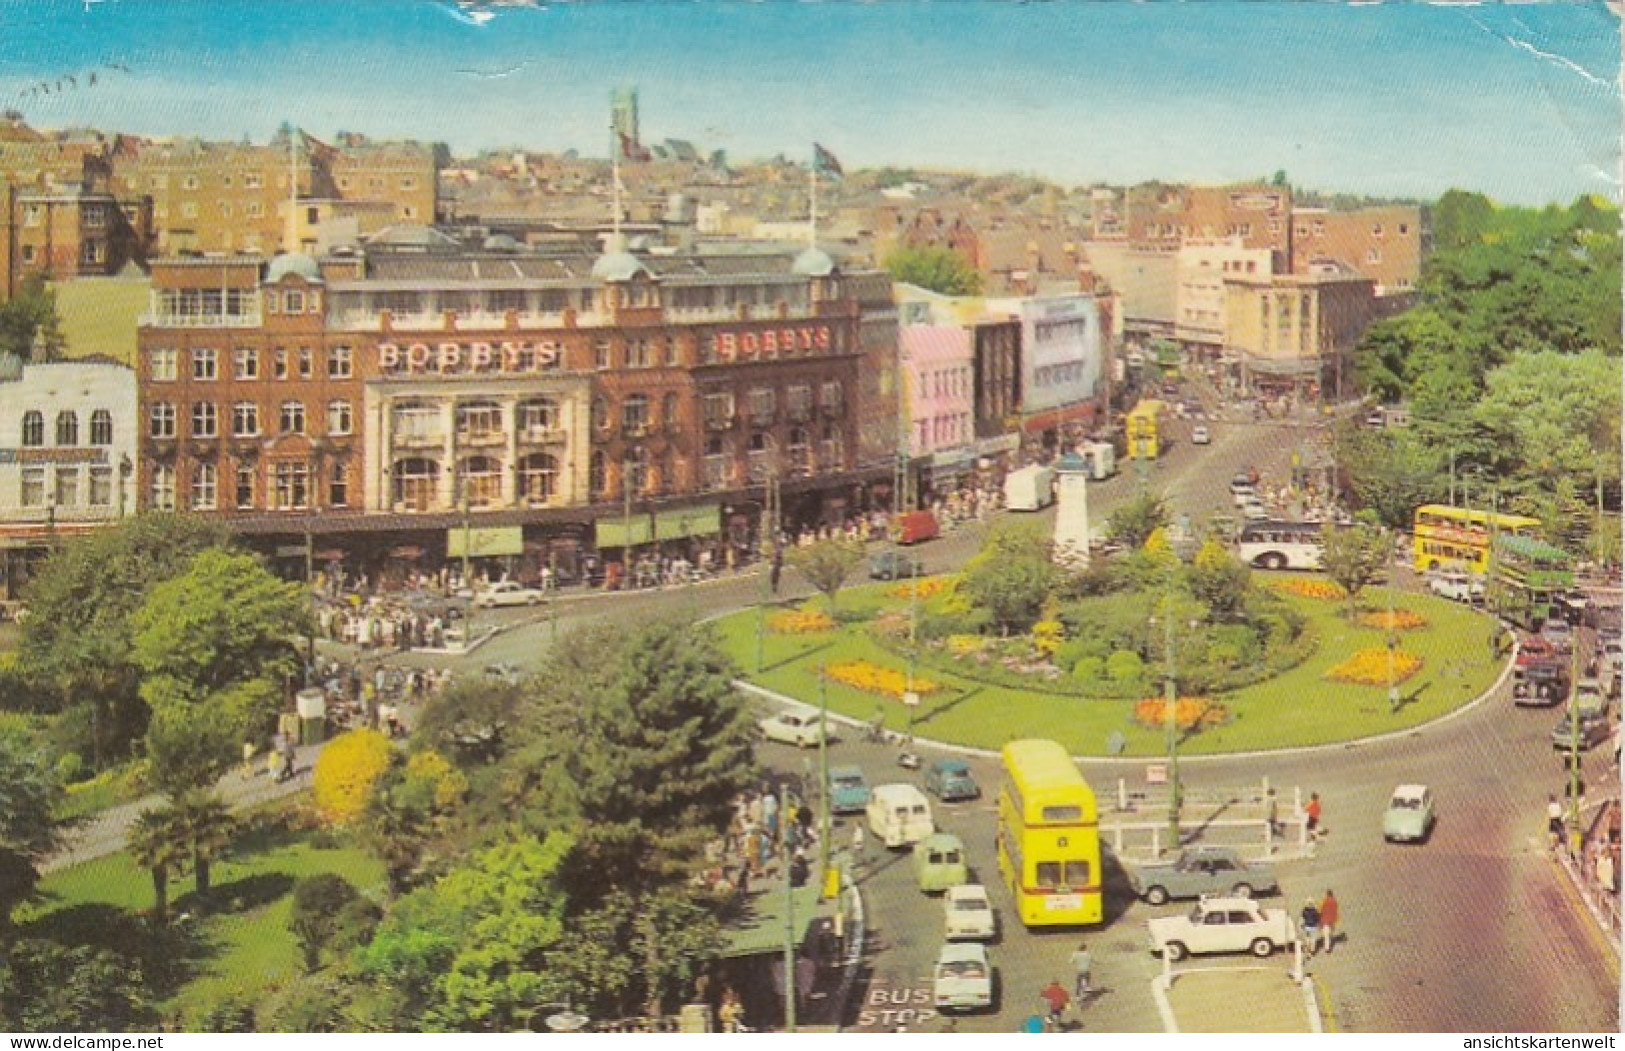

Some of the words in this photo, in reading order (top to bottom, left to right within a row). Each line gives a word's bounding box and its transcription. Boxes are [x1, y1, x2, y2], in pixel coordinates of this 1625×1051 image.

[713, 326, 830, 355] BOBBYS
[378, 341, 557, 367] BOBBYS
[869, 988, 931, 1005] BUS
[859, 1008, 938, 1026] STOP
